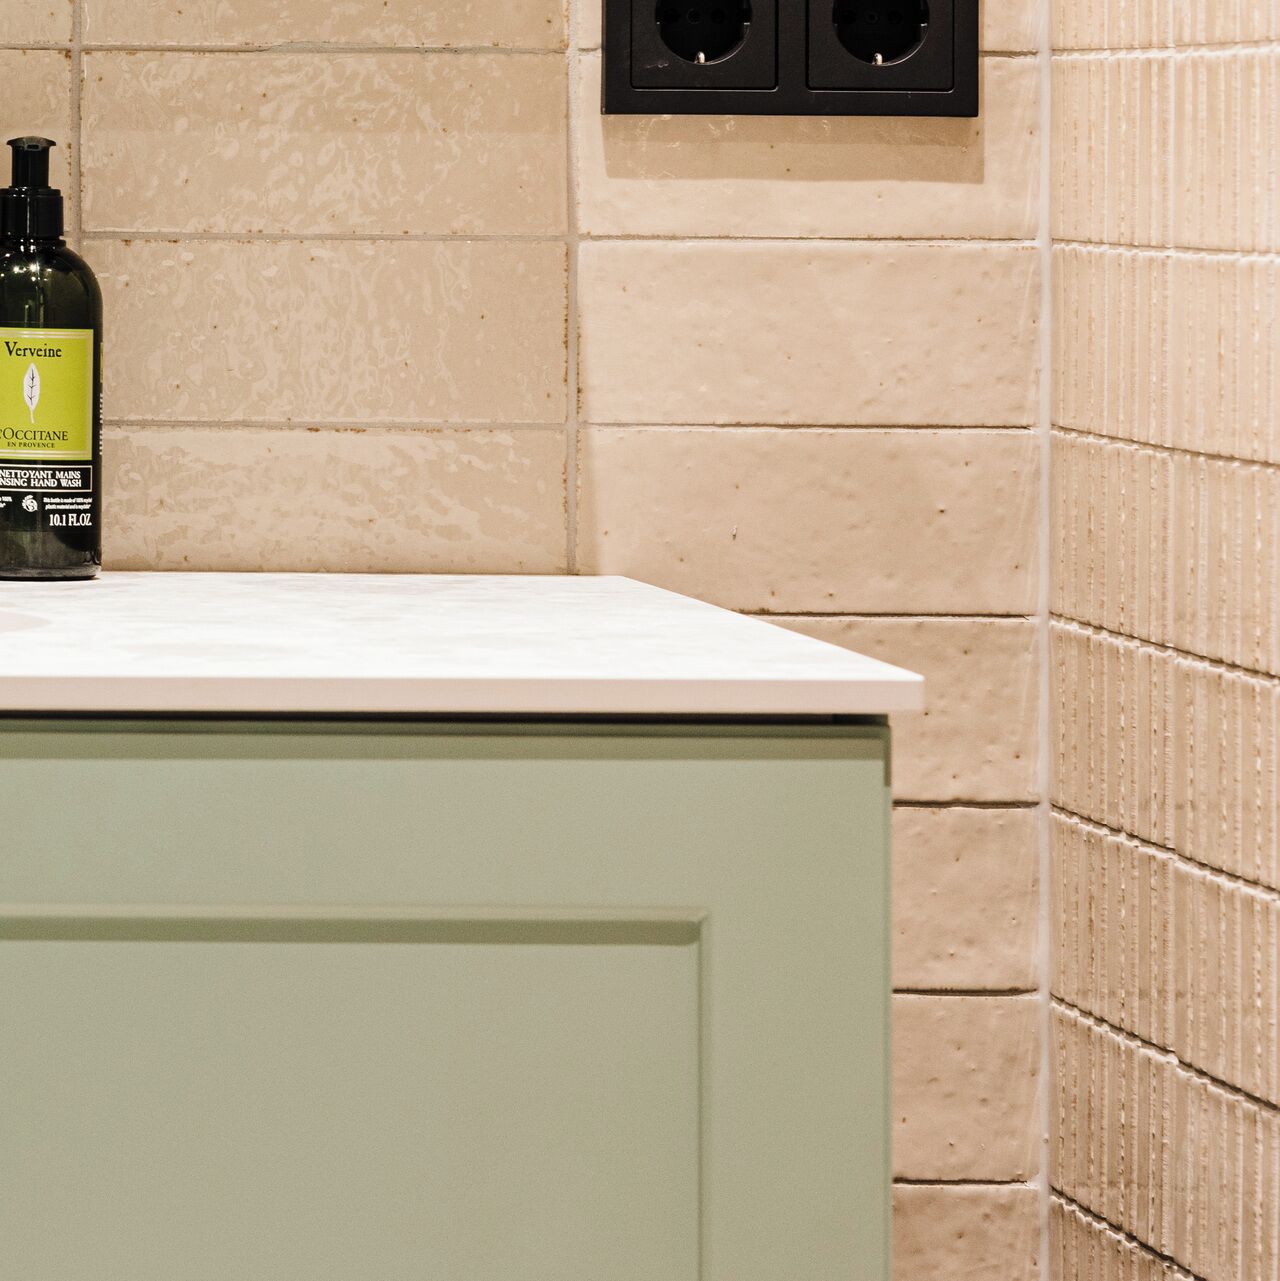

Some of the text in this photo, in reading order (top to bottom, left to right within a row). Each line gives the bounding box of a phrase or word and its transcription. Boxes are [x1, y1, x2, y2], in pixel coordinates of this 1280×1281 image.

[5, 342, 62, 357] Verveine
[0, 469, 53, 479] NETTOYANT
[56, 471, 81, 479] MAINS
[60, 479, 82, 487] WASH
[49, 514, 66, 526] 10.1
